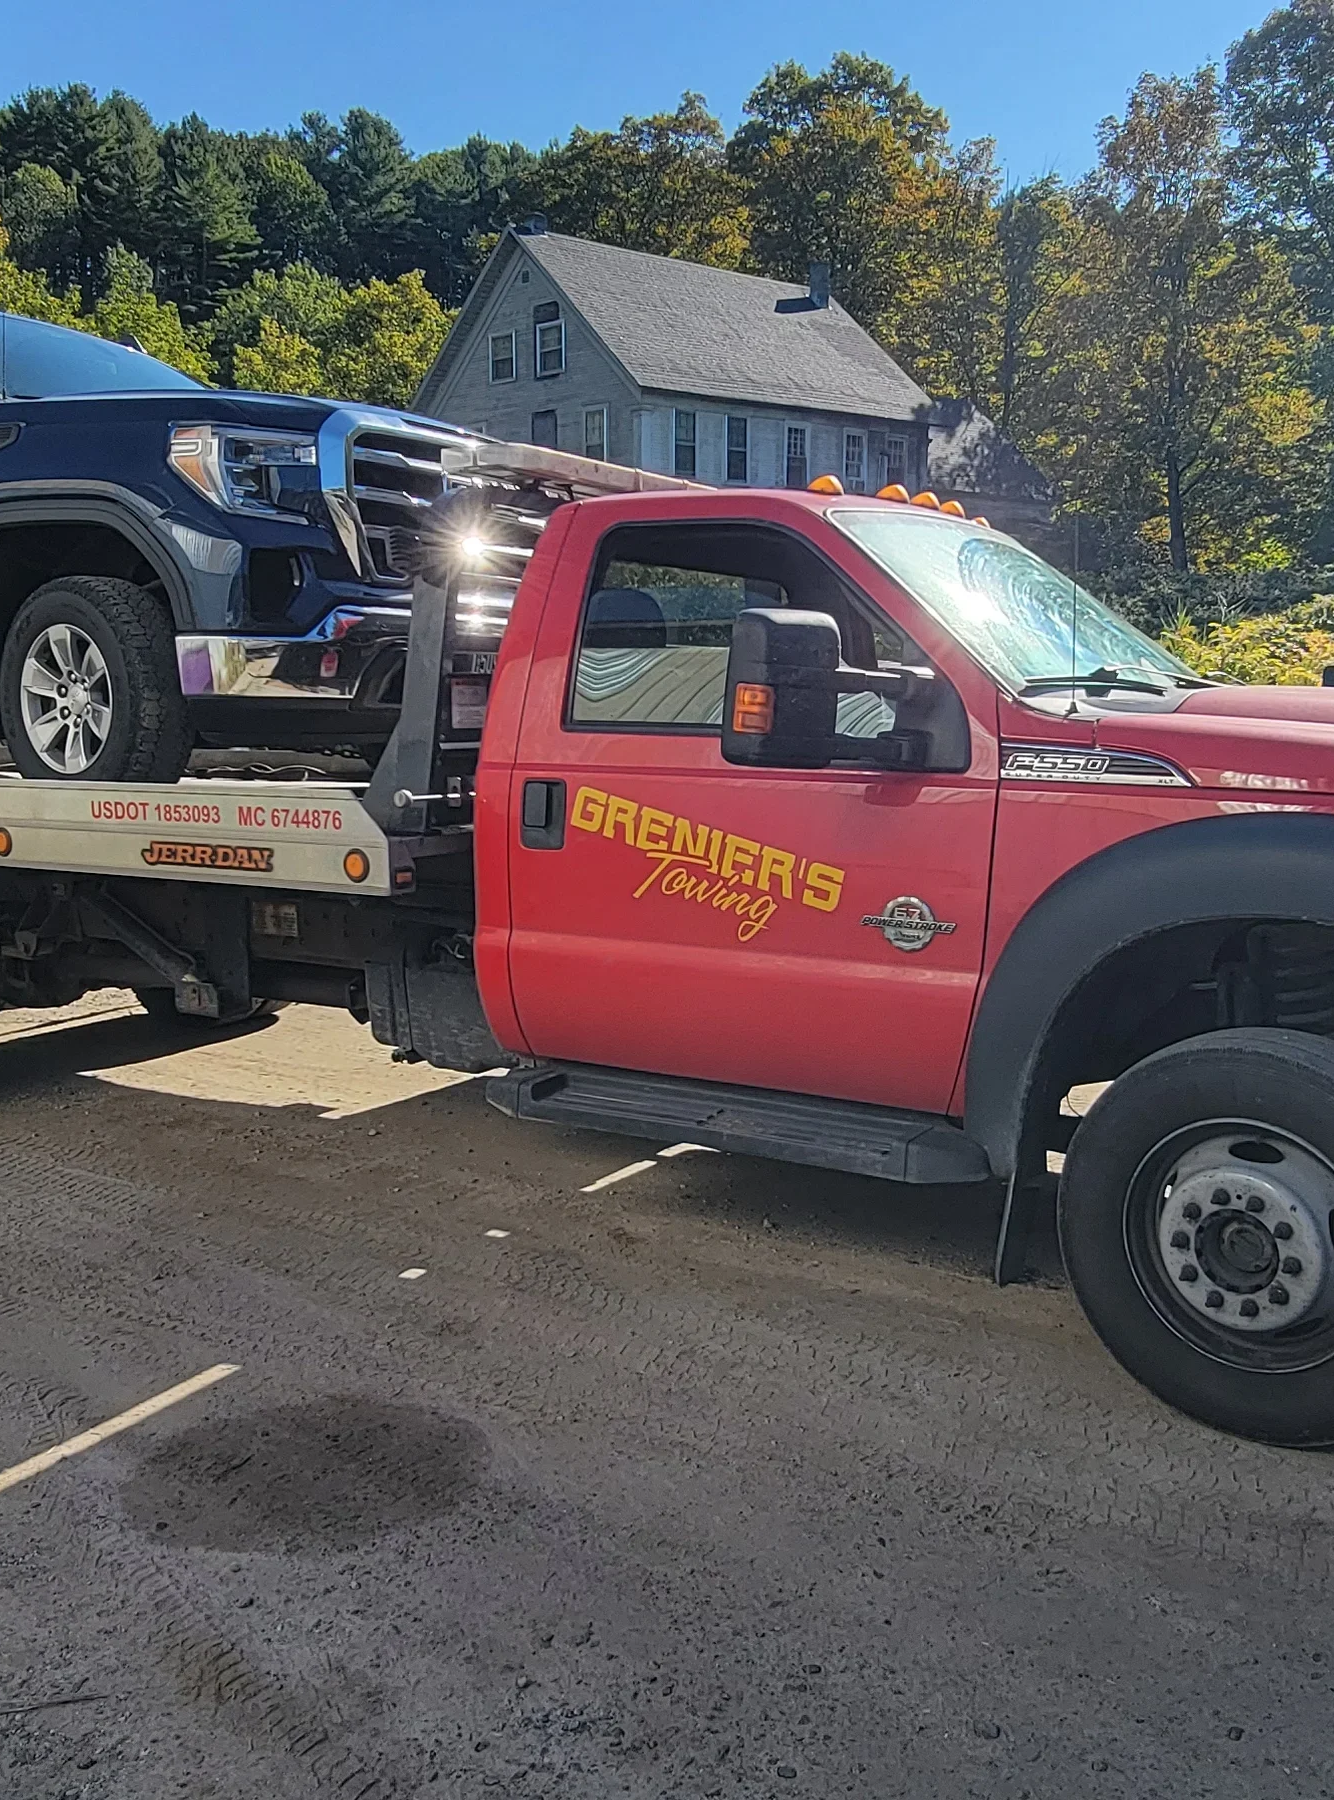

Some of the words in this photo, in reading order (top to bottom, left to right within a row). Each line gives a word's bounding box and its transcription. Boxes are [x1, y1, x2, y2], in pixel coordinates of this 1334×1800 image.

[91, 800, 149, 820] USDOT
[154, 804, 221, 824] 1853093
[238, 806, 266, 827] MC
[271, 808, 343, 830] 6744876
[570, 785, 845, 912] GRENIER'S
[632, 851, 778, 943] Towing
[861, 916, 902, 928] POWER
[904, 920, 955, 932] STROKE
